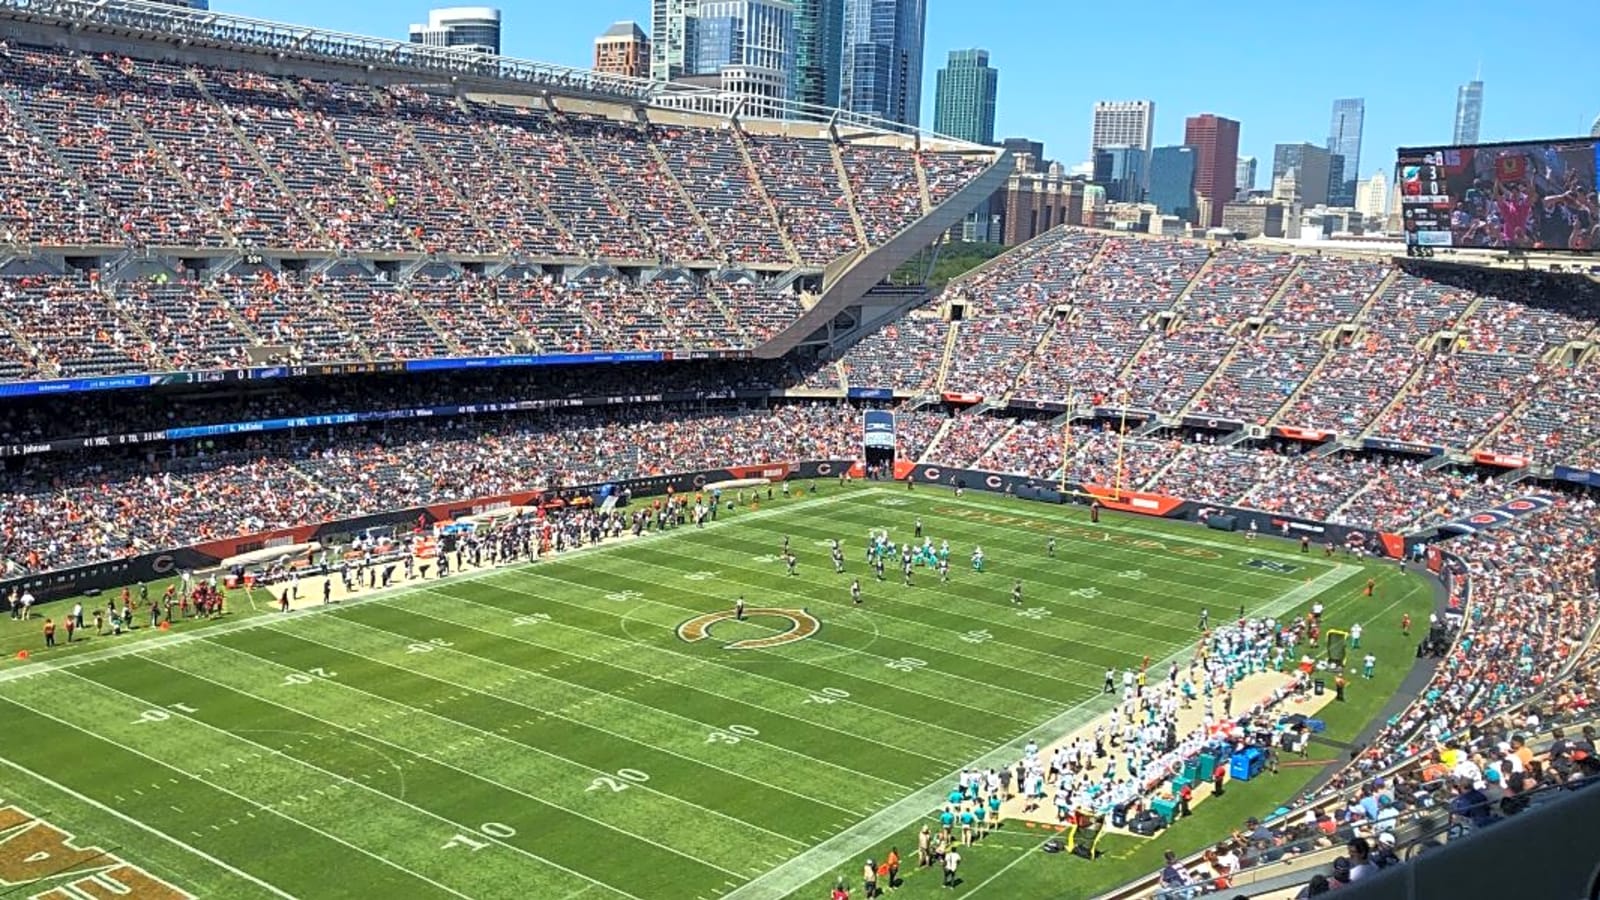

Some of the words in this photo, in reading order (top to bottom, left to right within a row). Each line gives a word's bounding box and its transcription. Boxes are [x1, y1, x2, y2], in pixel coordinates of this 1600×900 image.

[1430, 166, 1437, 180] 3
[1431, 182, 1439, 195] 0
[187, 373, 194, 383] 3
[238, 371, 244, 380] 0
[119, 435, 125, 443] 0
[817, 463, 831, 475] C
[924, 468, 940, 480] C
[986, 475, 1002, 487] C
[153, 554, 174, 573] C
[676, 607, 821, 650] C
[809, 687, 850, 705] 40
[707, 724, 760, 745] 30
[592, 768, 650, 792] 20
[449, 822, 517, 851] 10
